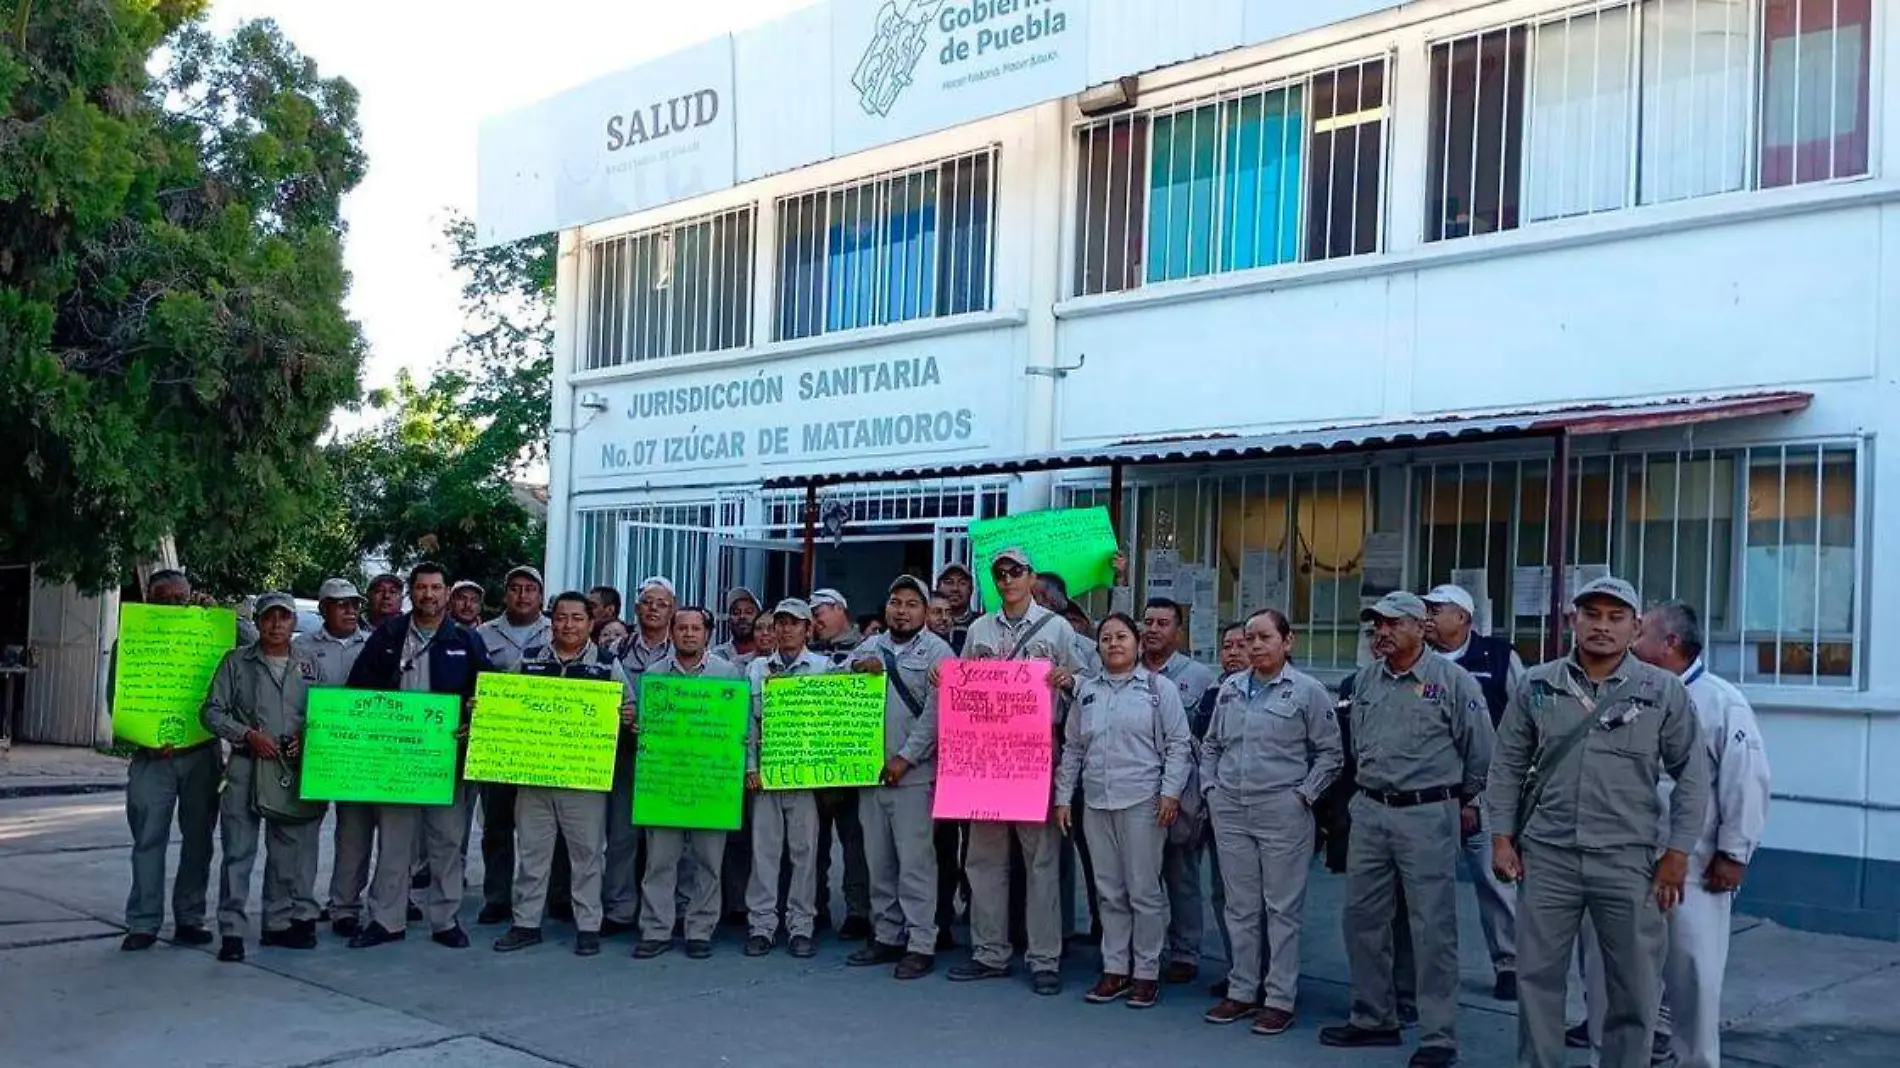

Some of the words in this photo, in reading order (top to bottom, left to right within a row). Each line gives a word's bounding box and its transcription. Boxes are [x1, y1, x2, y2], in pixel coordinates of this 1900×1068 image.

[939, 0, 1053, 33] Gobier
[939, 37, 969, 65] de
[977, 8, 1067, 56] Puebla
[607, 88, 718, 151] SALUD
[627, 371, 784, 420] JURISDICCIÓN
[799, 356, 940, 400] SANITARIA
[663, 425, 745, 463] IZÚCAR
[758, 426, 789, 455] DE
[802, 409, 972, 452] MATAMOROS
[848, 677, 867, 691] 75
[423, 709, 444, 725] 75
[581, 703, 598, 718] 75
[763, 763, 876, 785] VECTORES
